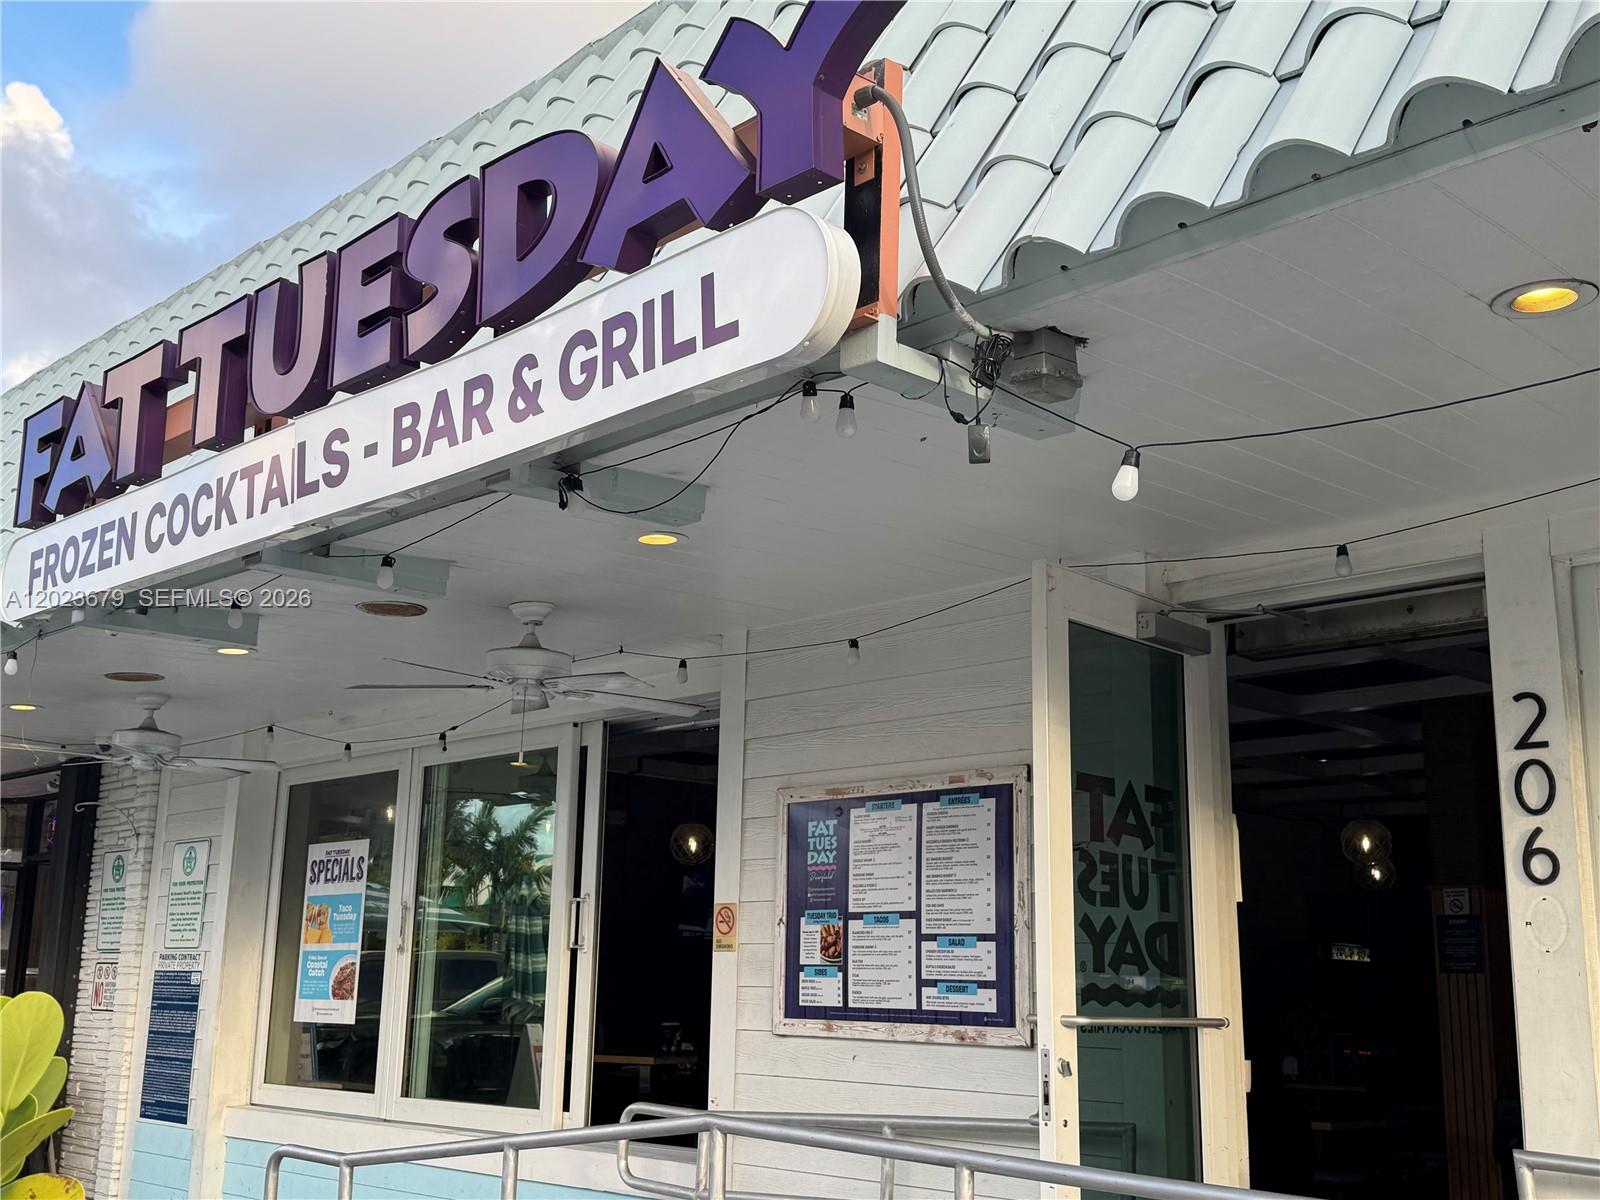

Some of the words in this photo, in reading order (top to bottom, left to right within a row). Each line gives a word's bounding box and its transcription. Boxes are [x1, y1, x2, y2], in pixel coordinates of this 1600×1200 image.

[13, 339, 187, 529] FAT
[178, 0, 907, 451] TUESDAY
[28, 511, 138, 597] FROZEN
[145, 427, 350, 555] COCKTAILS
[392, 373, 494, 467] BAR
[507, 353, 545, 423] &
[558, 271, 740, 401] GRILL
[1512, 692, 1560, 886] 206
[872, 802, 894, 810] STARTERS
[807, 819, 838, 837] FAT
[808, 836, 837, 851] TUES
[807, 850, 837, 865] DAY
[309, 856, 365, 884] SPECIALS
[339, 904, 352, 913] Taco
[333, 912, 357, 921] Tuesday
[807, 912, 826, 921] TUESDAY
[874, 915, 890, 924] TACOS
[948, 938, 966, 947] SALAD
[159, 953, 177, 962] PARKING
[178, 952, 202, 962] CONTRACT
[158, 961, 176, 971] PRIVATE
[176, 960, 201, 971] PROPERTY
[306, 960, 328, 969] Coastal
[308, 968, 325, 977] Catch
[814, 968, 828, 977] SIDES
[946, 985, 969, 993] DESSERT
[92, 981, 104, 1007] NO
